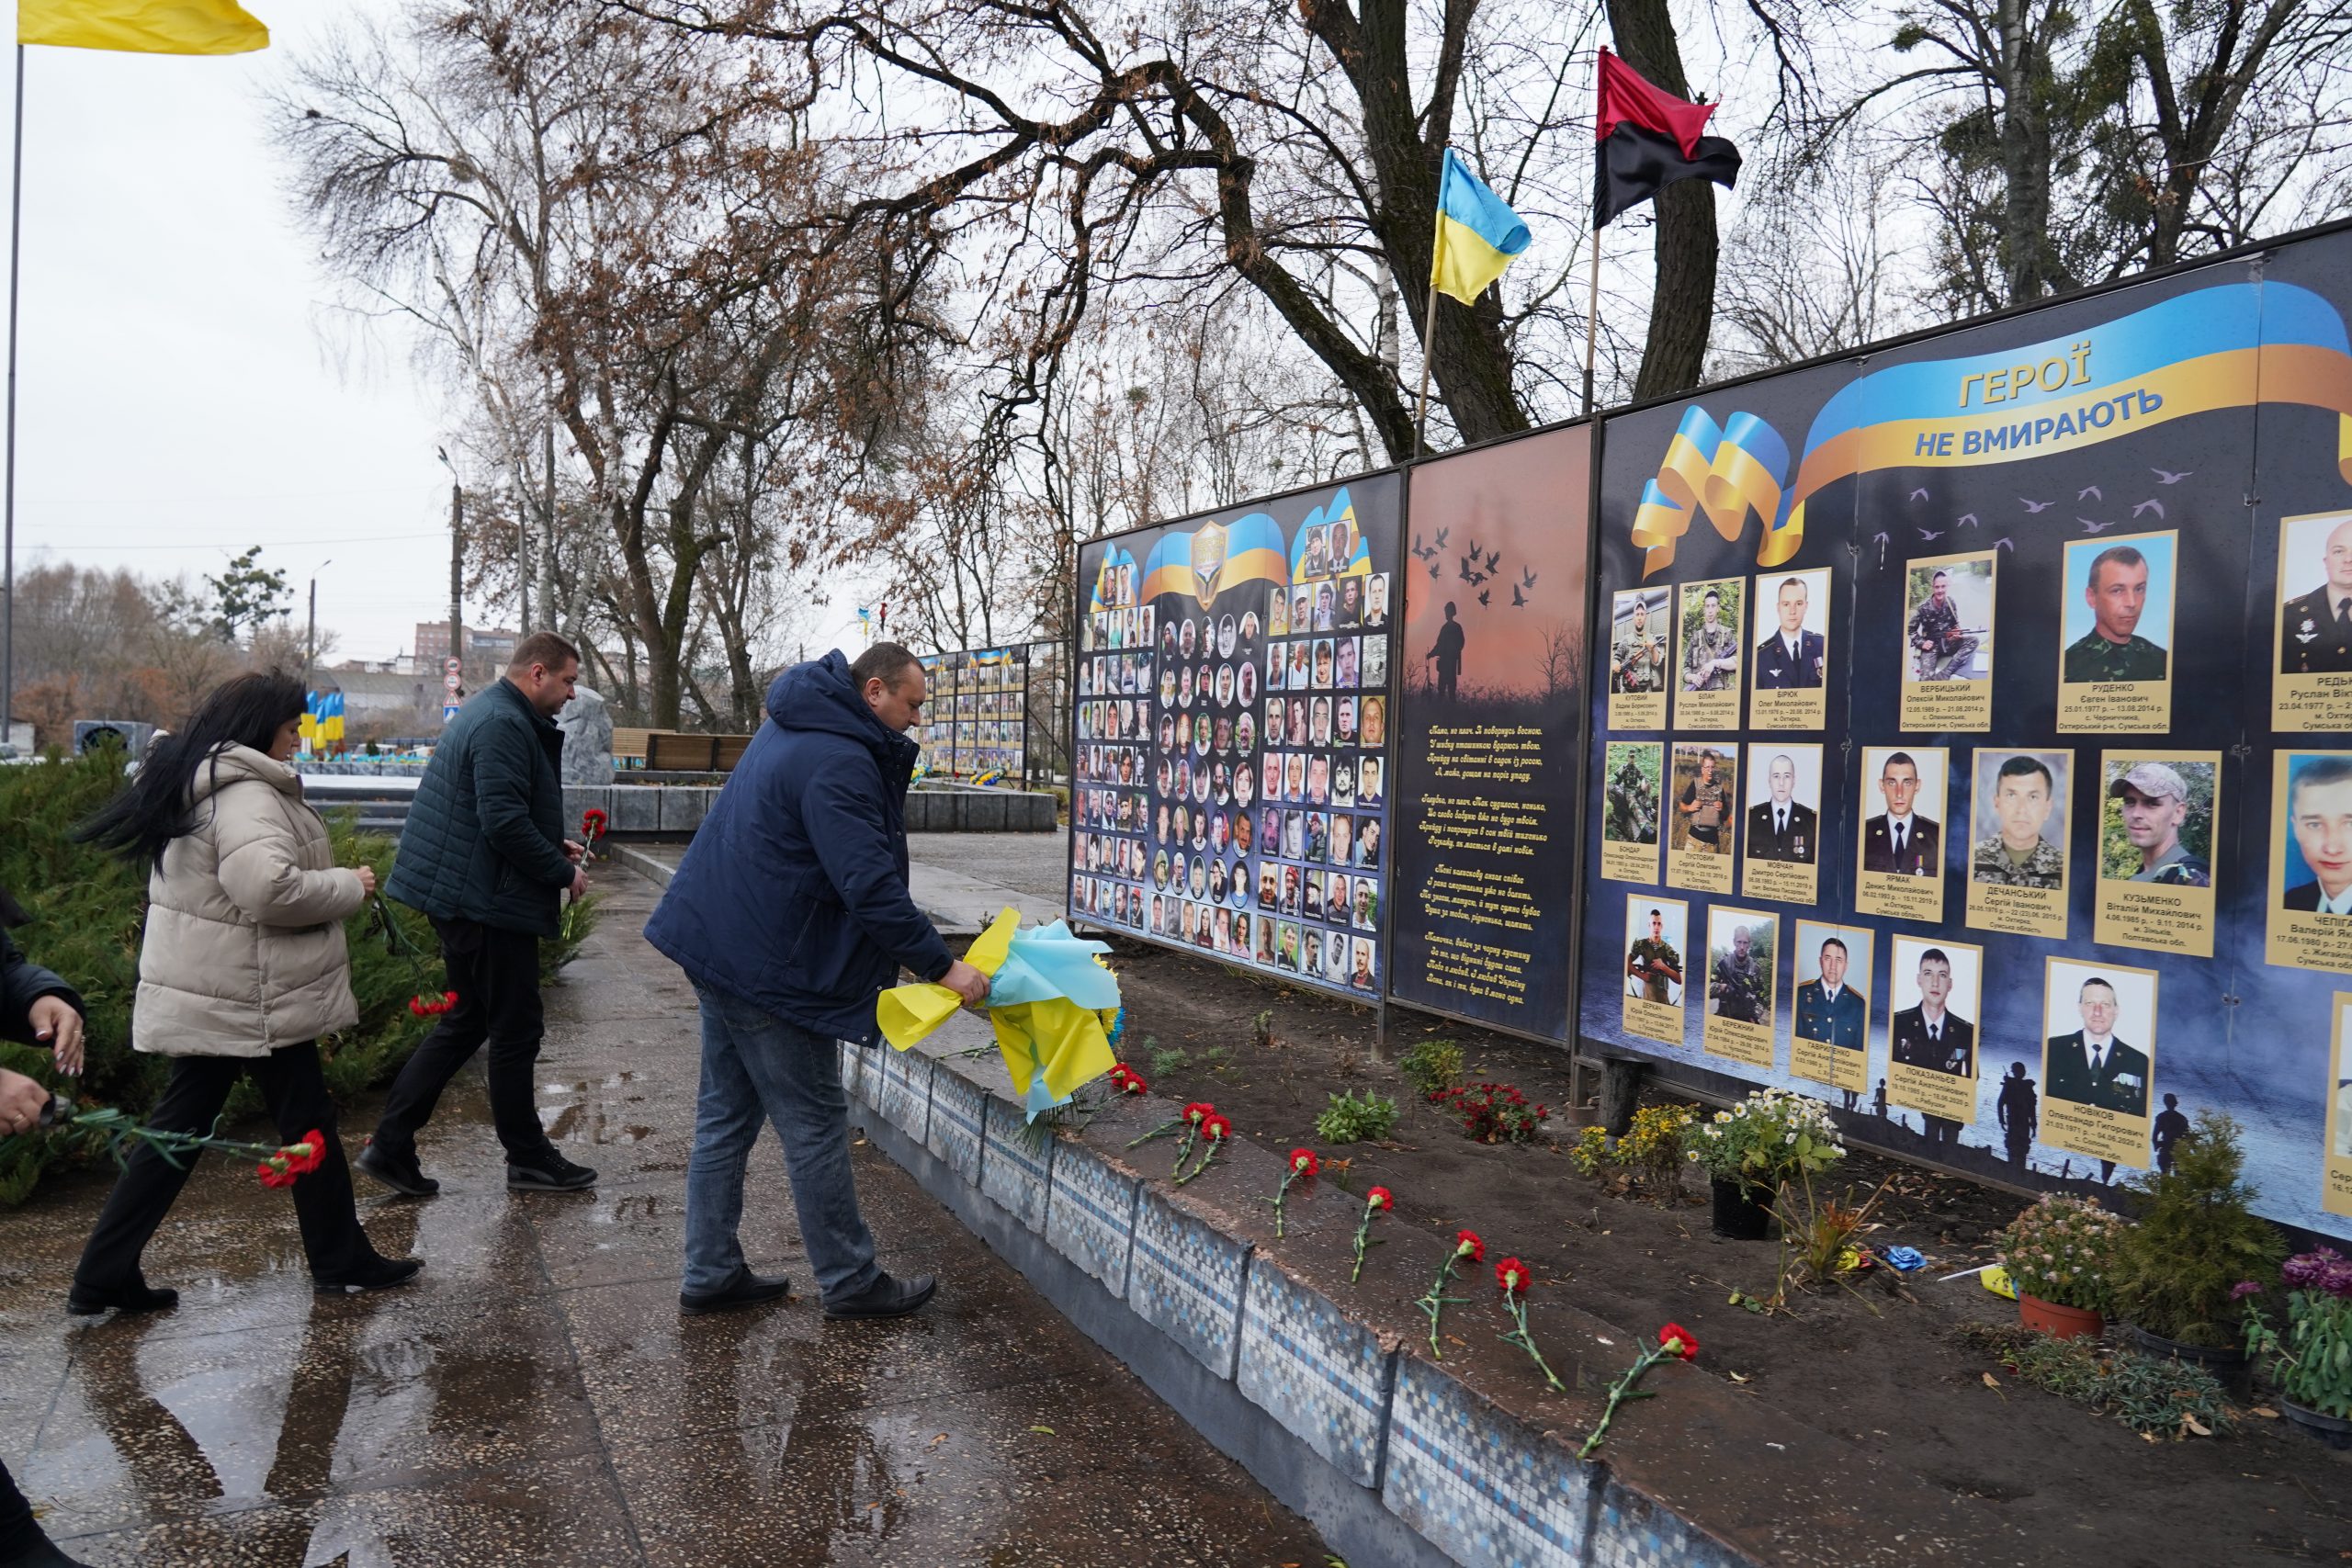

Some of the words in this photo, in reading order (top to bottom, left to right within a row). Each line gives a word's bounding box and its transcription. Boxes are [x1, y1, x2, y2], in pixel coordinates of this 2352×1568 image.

[1958, 340, 2091, 407] ГЕРОЇ
[1915, 433, 1954, 457] НЕ
[1962, 389, 2163, 455] ВМИРАЮТЬ
[1920, 683, 1970, 693] ВЕРБИЦЬКИЙ
[2092, 683, 2134, 693] РУДЕНКО
[2290, 690, 2330, 700] Руслан
[2302, 722, 2342, 730] Сумська
[1886, 874, 1911, 883] ЯРМАК
[1865, 882, 1885, 890] Денис
[1887, 885, 1933, 895] Миколайович
[1987, 886, 2046, 899] ДЕЧАНСЬКИЙ
[1984, 897, 2010, 907] Сергій
[2013, 900, 2052, 911] Іванович
[2123, 893, 2181, 907] КУЗЬМЕНКО
[2107, 902, 2139, 913] Віталій
[2142, 906, 2201, 919] Михайлович
[2290, 924, 2335, 937] Валерій
[2048, 1110, 2094, 1127] Олександр
[2074, 1105, 2114, 1121] НОВІКОВ
